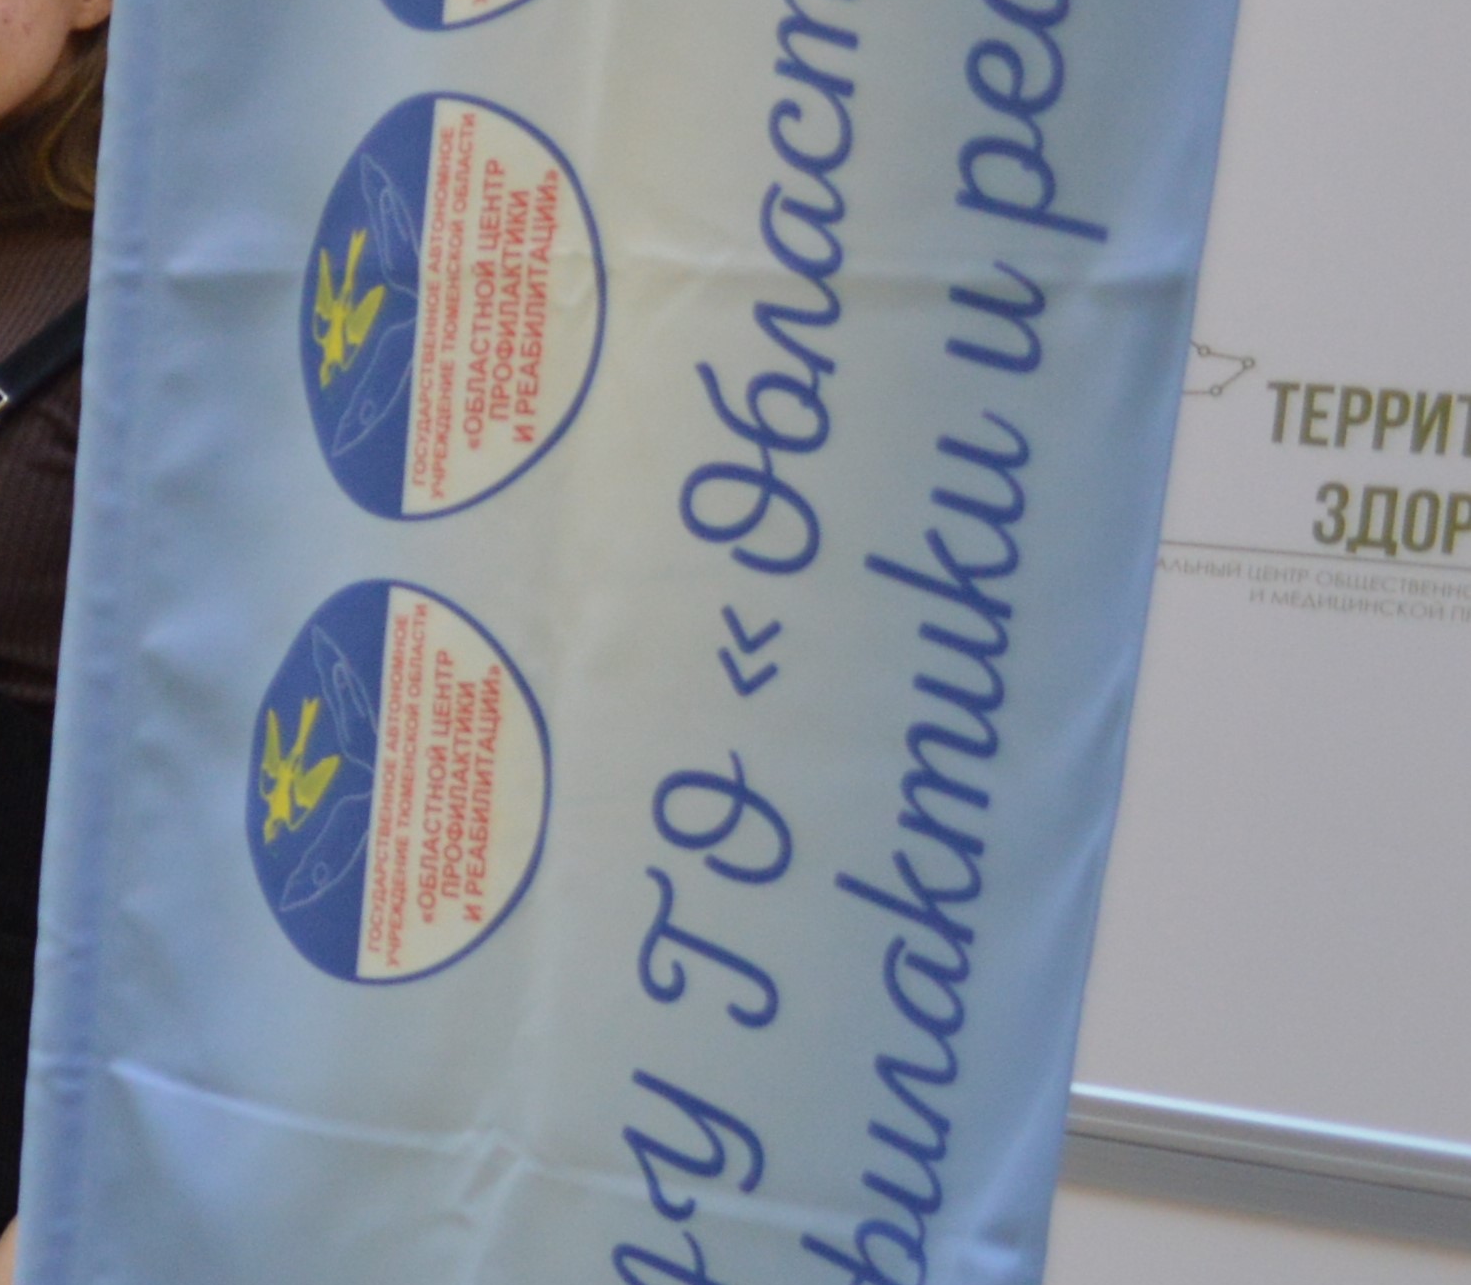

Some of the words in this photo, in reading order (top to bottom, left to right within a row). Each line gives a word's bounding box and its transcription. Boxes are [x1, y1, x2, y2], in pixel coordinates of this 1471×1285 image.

[453, 112, 476, 213] ОБЛАСТИ
[478, 157, 506, 254] ЦЕНТР
[412, 281, 441, 487] ГОСУДАРСТВЕННОЕ
[427, 126, 455, 275] АВТОНОМНОЕ
[441, 219, 465, 354] ТЮМЕНСКОЙ
[489, 189, 530, 422] ПРОФИЛАКТИКИ
[516, 167, 560, 417] РЕАБИЛИТАЦИИ»
[945, 260, 1047, 374] и
[463, 259, 497, 452] «ОБЛАСТНОЙ
[430, 357, 457, 499] УЧРЕЖДЕНИЕ
[513, 423, 534, 444] И
[1156, 555, 1242, 579] АЛЬНЫЙ
[1311, 481, 1471, 557] ЗДОР
[408, 602, 428, 699] ОБЛАСТИ
[431, 648, 455, 742] ЦЕНТР
[368, 759, 398, 954] ГОСУДАРСТВЕННОЕ
[386, 614, 409, 753] АВТОНОМНОЕ
[397, 702, 420, 831] ТЮМЕНСКОЙ
[441, 679, 476, 900] ПРОФИЛАКТИКИ
[465, 664, 502, 898] РЕАБИЛИТАЦИИ»
[388, 834, 410, 968] УЧРЕЖДЕНИЕ
[417, 748, 448, 925] «ОБЛАСТНОЙ
[638, 750, 793, 1028] ТО
[463, 903, 482, 924] И
